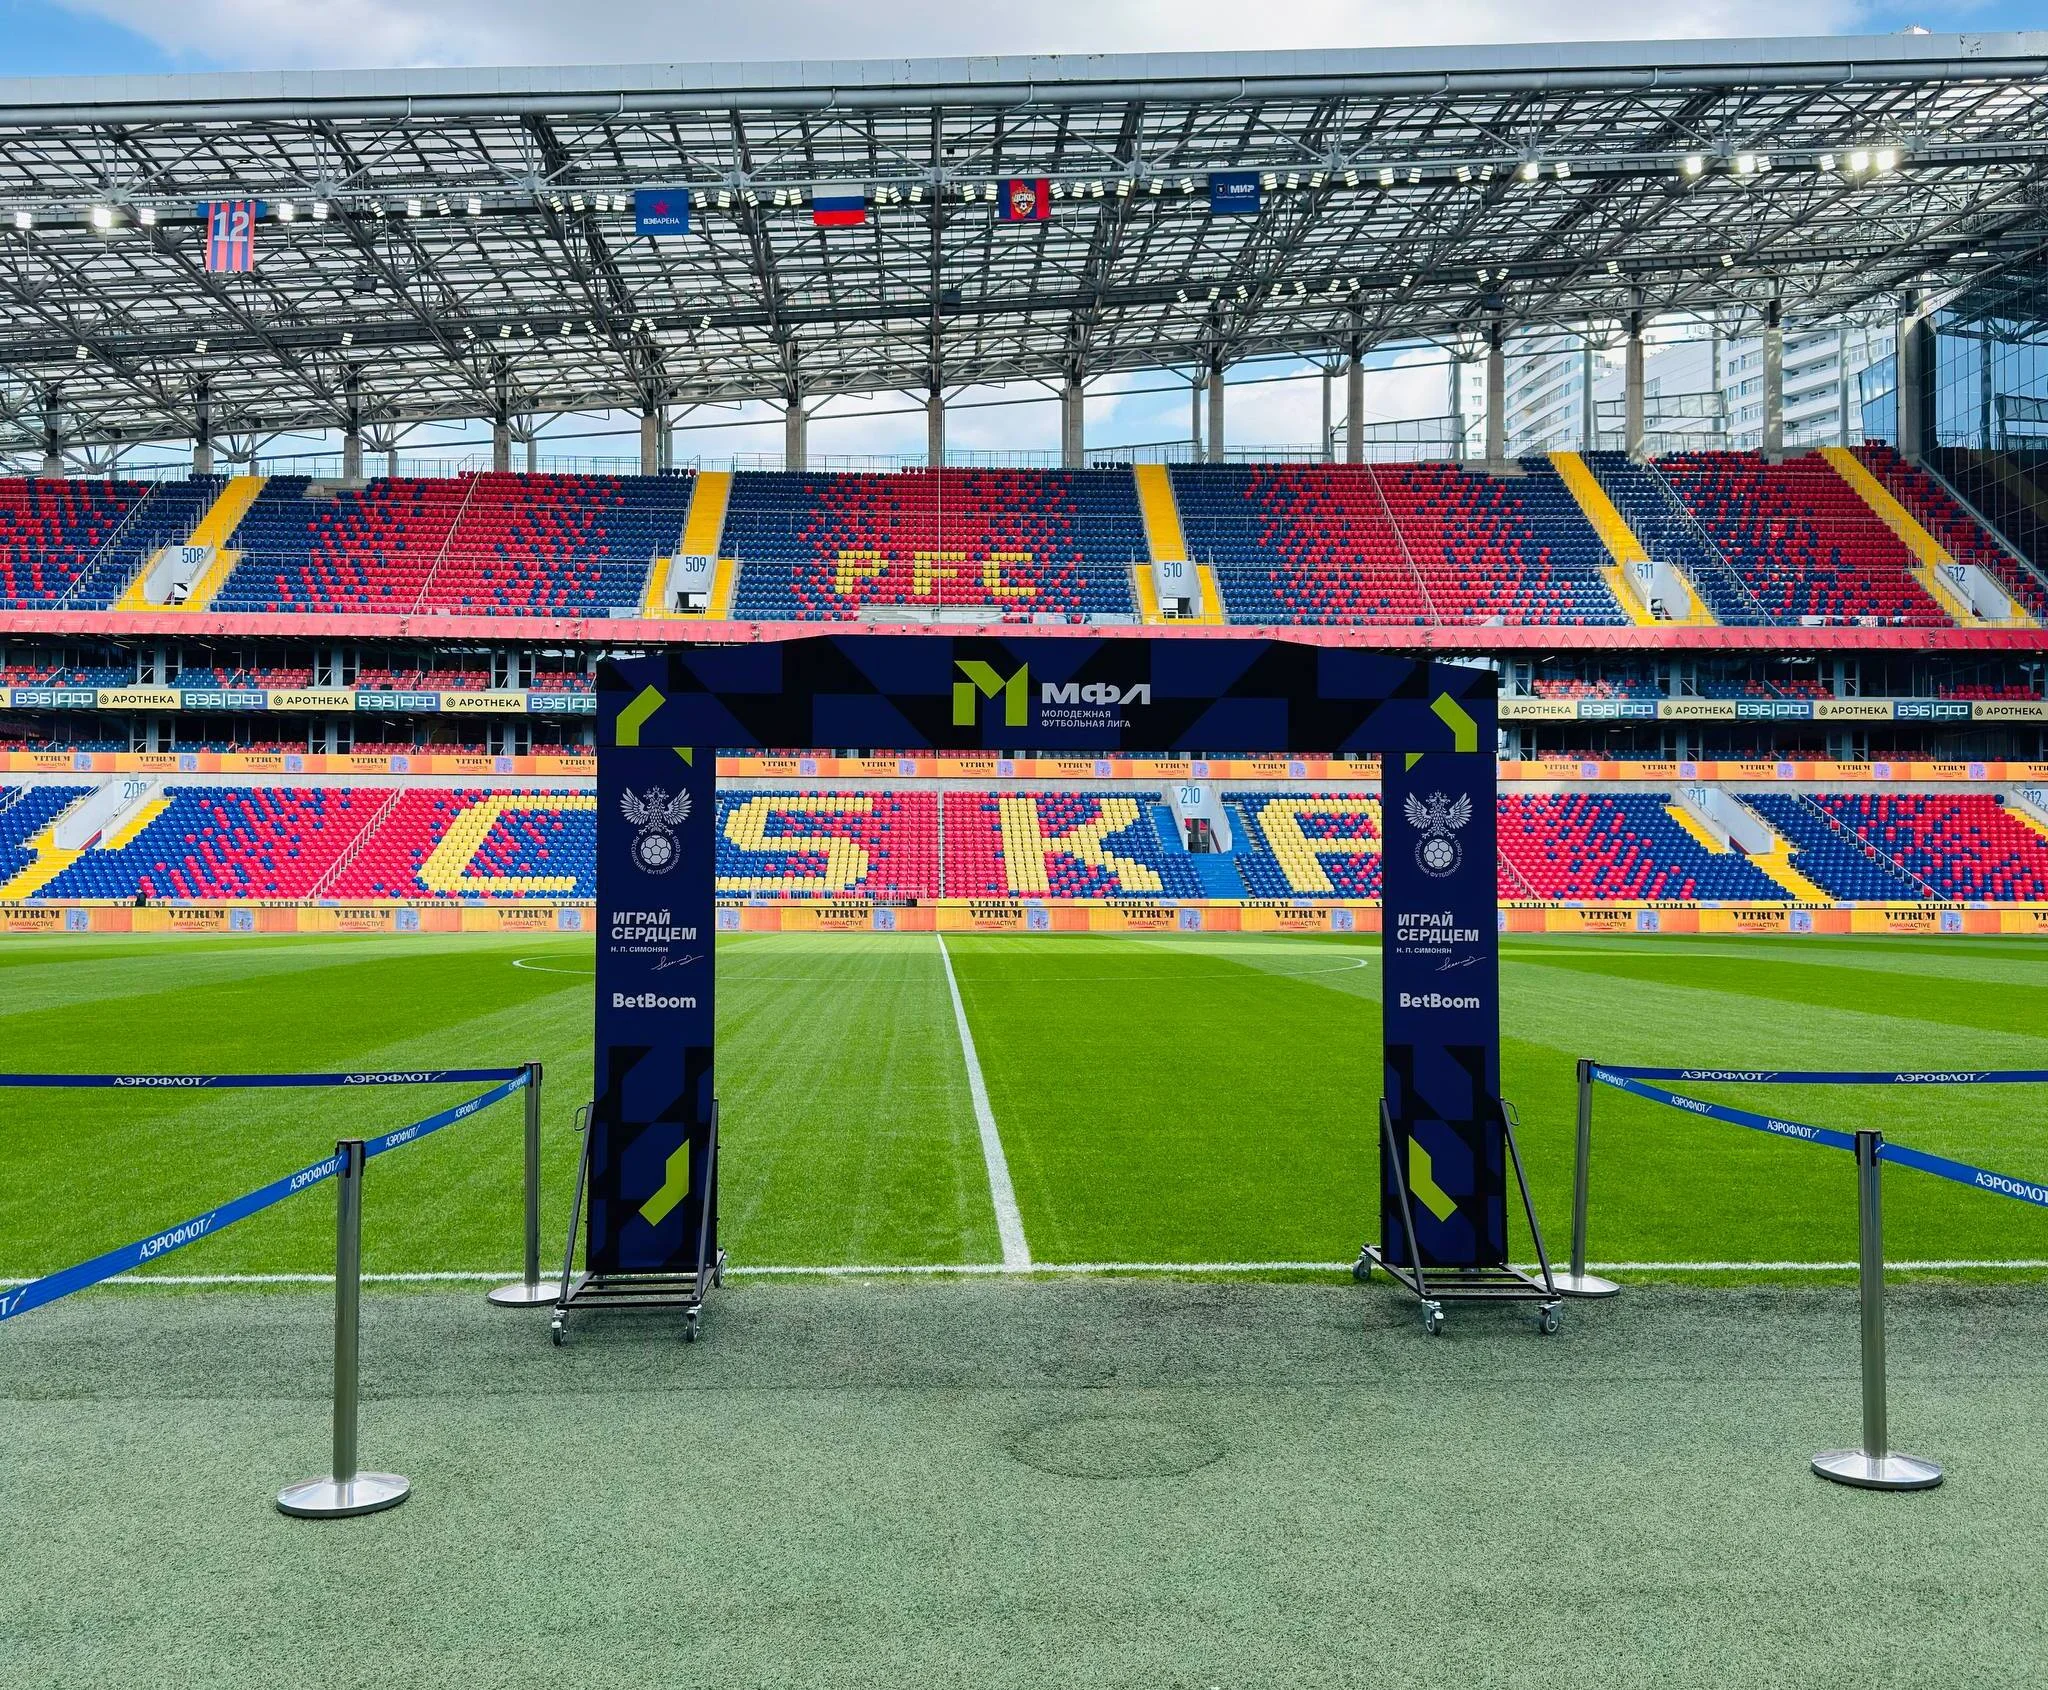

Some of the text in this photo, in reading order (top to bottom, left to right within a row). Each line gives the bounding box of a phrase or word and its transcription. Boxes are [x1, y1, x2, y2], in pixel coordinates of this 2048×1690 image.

[1230, 184, 1255, 194] МИР
[213, 211, 250, 242] 12
[182, 547, 204, 564] 508
[685, 556, 707, 572] 509
[834, 551, 1037, 596] PFC
[1163, 562, 1183, 578] 510
[1636, 563, 1654, 579] 511
[1947, 566, 1966, 582] 512
[1041, 682, 1151, 705] МФЛ
[112, 695, 175, 704] APOTHEKA
[286, 696, 350, 705] APOTHEKA
[458, 698, 522, 707] APOTHEKA
[1041, 709, 1111, 718] МОЛОДЕЖНАЯ
[1513, 706, 1571, 714] APOTHEKA
[1675, 706, 1734, 715] APOTHEKA
[1831, 706, 1888, 715] APOTHEKA
[1986, 706, 2043, 716] APOTHEKA
[1041, 719, 1131, 728] ФУТБОЛЬНАЯ ЛИГА
[1180, 787, 1201, 804] 210
[4, 910, 60, 919] VITRUM
[168, 910, 225, 919] VITRUM
[334, 910, 390, 919] VITRUM
[497, 910, 553, 919] VITRUM
[612, 908, 671, 925] ИГРАЙ
[815, 909, 868, 918] VITRUM
[969, 909, 1022, 918] VITRUM
[1122, 910, 1175, 919] VITRUM
[1275, 910, 1327, 919] VITRUM
[1398, 911, 1454, 926] ИГРАЙ
[1579, 911, 1632, 920] VITRUM
[1732, 911, 1785, 920] VITRUM
[1884, 912, 1936, 921] VITRUM
[611, 927, 697, 942] СЕРДЦЕМ
[1397, 928, 1479, 944] СЕРДЦЕМ
[612, 993, 697, 1008] BetBoom
[1400, 992, 1480, 1009] BetBoom
[343, 1072, 433, 1084] АЭРОФЛОТ
[1681, 1070, 1765, 1081] АЭРОФЛОТ
[1894, 1073, 1977, 1082] АЭРОФЛОТ
[113, 1077, 203, 1086] АЭРОФЛОТ
[1671, 1095, 1707, 1114] АЭРОФЛОТ
[1767, 1119, 1813, 1139] АЭРОФЛОТ
[385, 1126, 416, 1148] АЭРОФЛОТ
[289, 1158, 338, 1192] АЭРОФЛОТ
[139, 1217, 208, 1260] АЭРОФЛОТ
